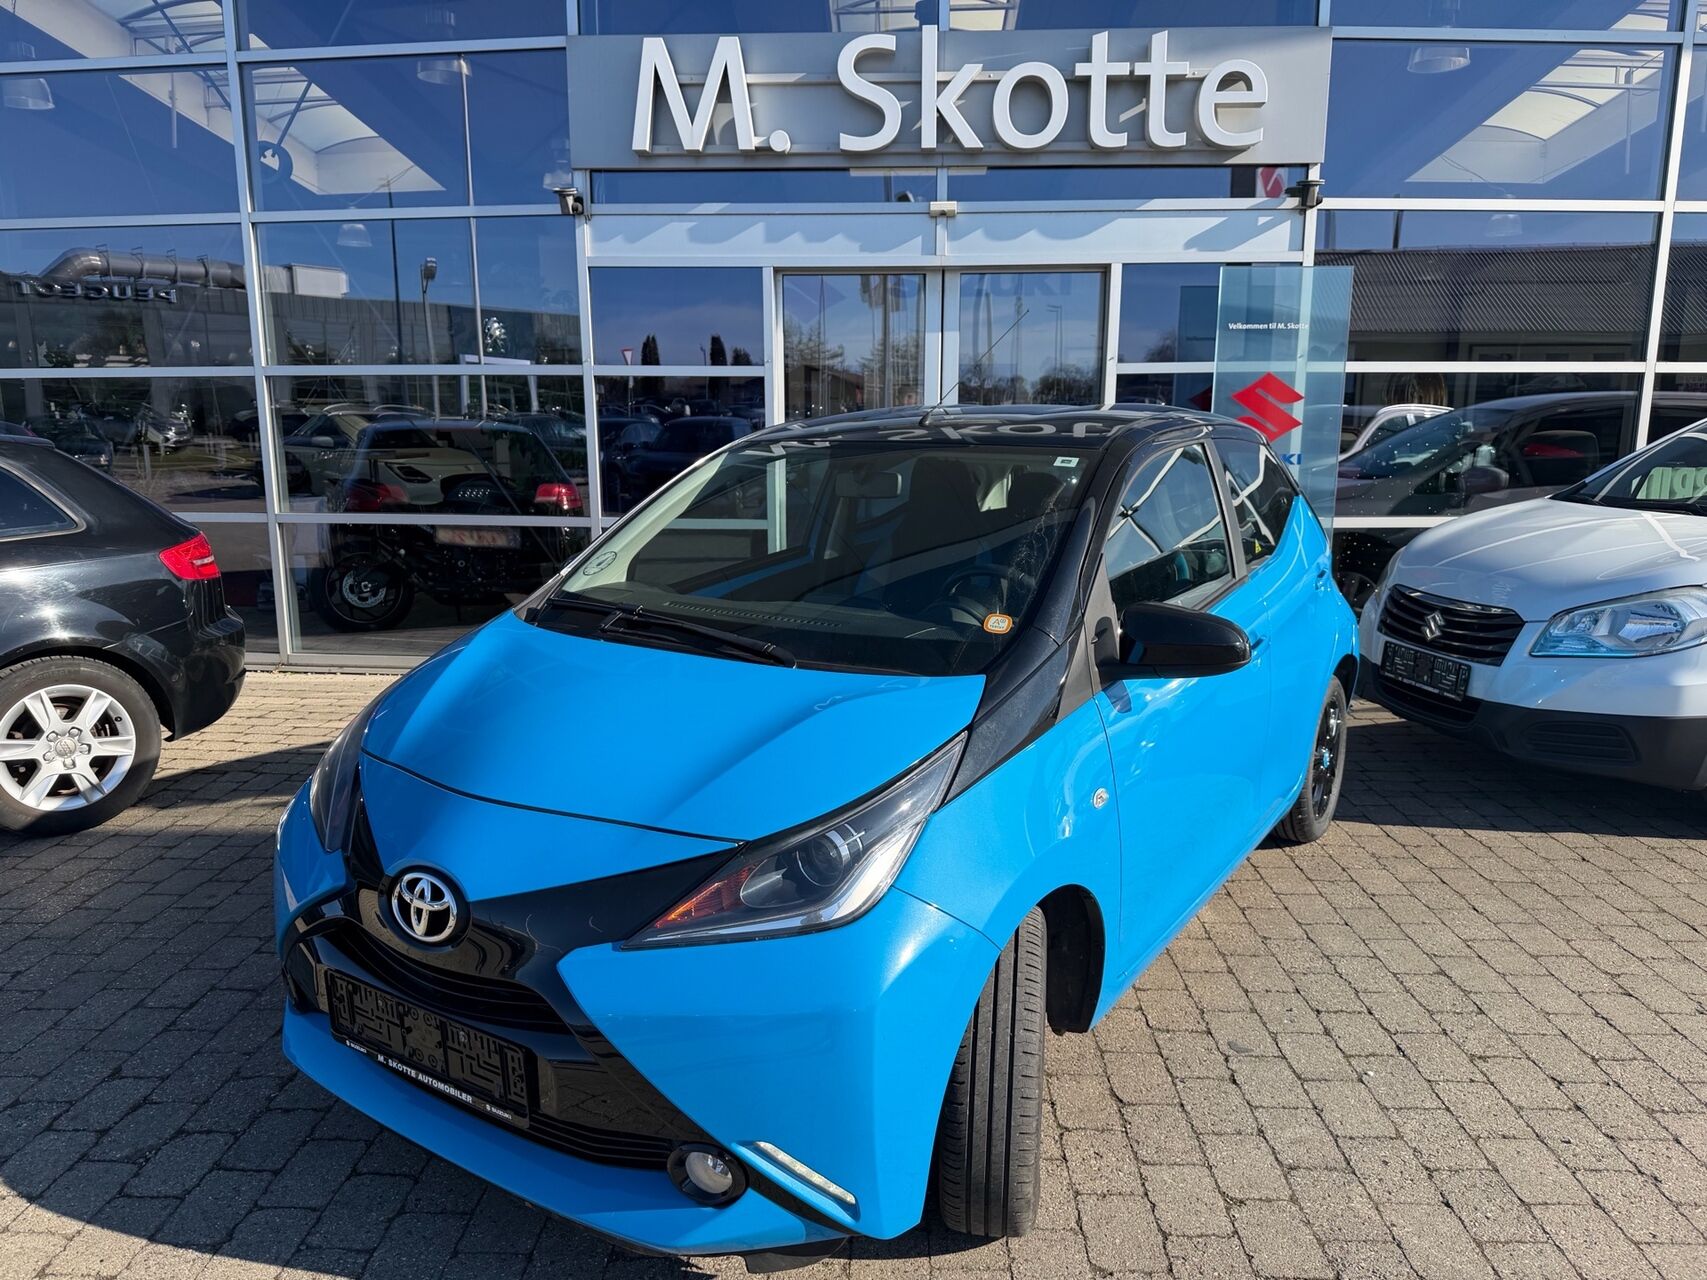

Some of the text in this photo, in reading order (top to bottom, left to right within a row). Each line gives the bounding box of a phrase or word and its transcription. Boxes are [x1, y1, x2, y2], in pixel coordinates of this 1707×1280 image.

[632, 24, 1268, 155] M. Skotte
[1228, 322, 1310, 330] Velkommen til M. Skotte
[377, 1053, 473, 1104] M. SKOTTE AUTOMOBILER
